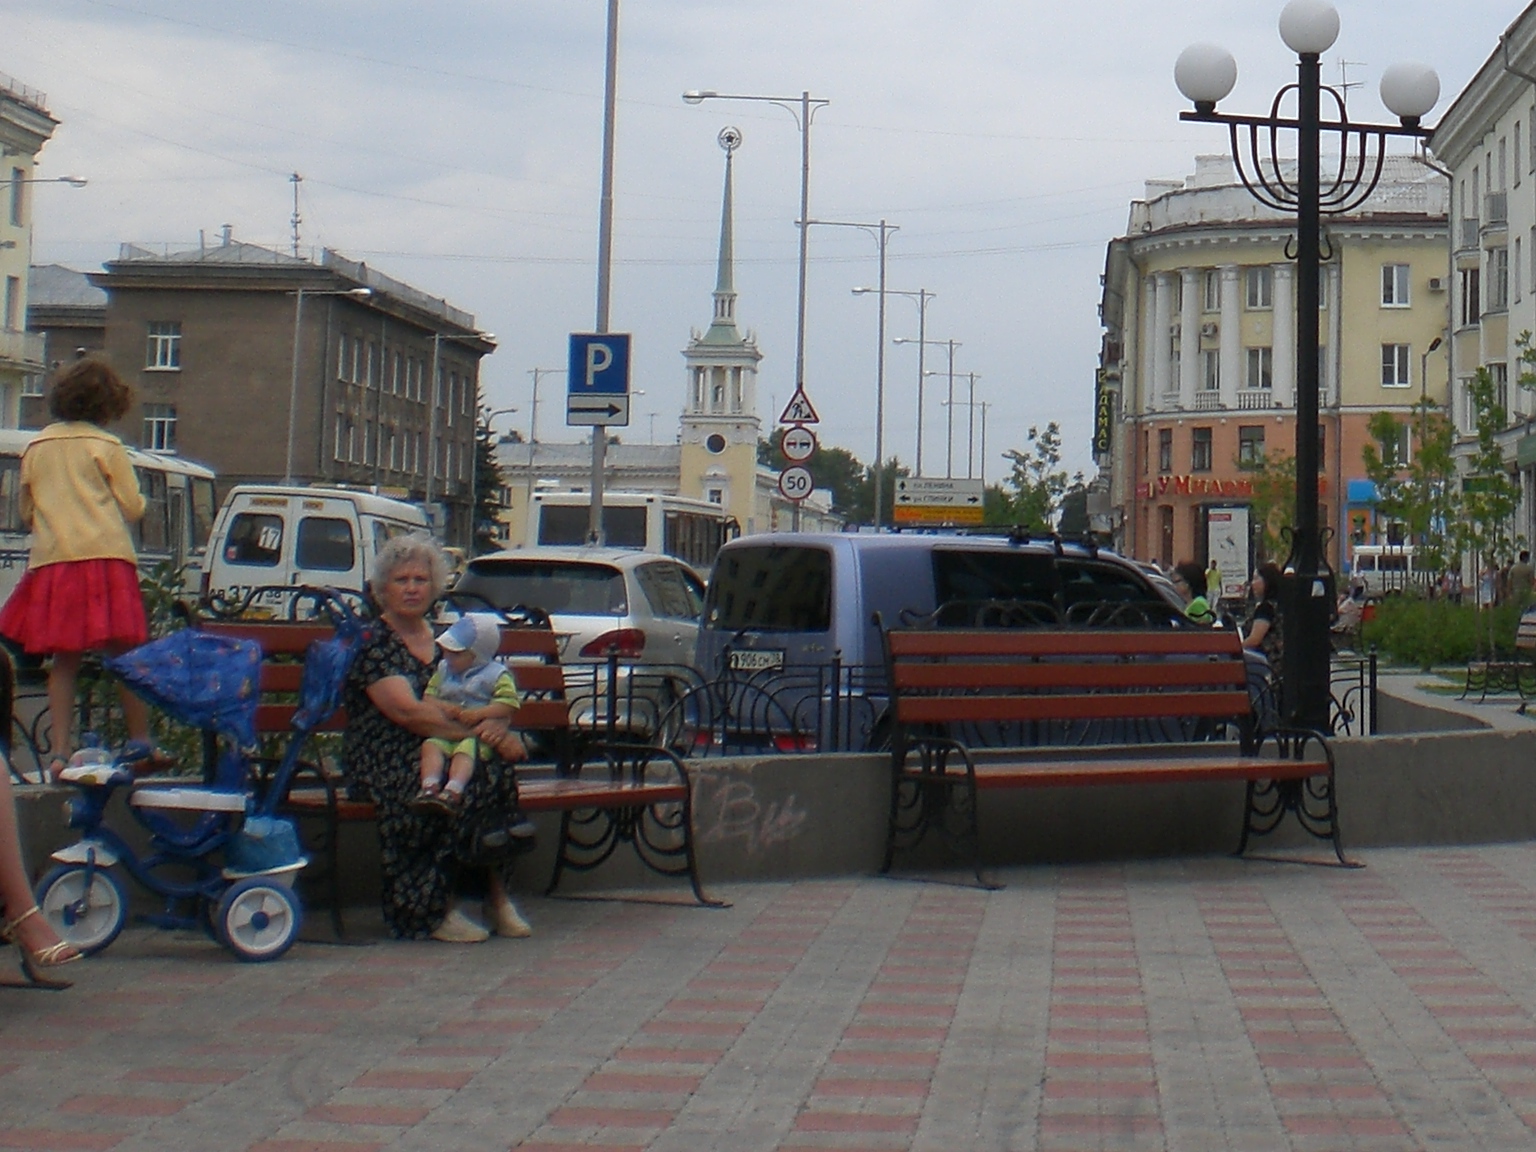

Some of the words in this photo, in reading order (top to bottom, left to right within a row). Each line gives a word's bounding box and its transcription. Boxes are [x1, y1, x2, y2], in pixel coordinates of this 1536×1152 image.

[586, 343, 613, 385] P
[787, 475, 807, 491] 50
[262, 528, 279, 548] 17
